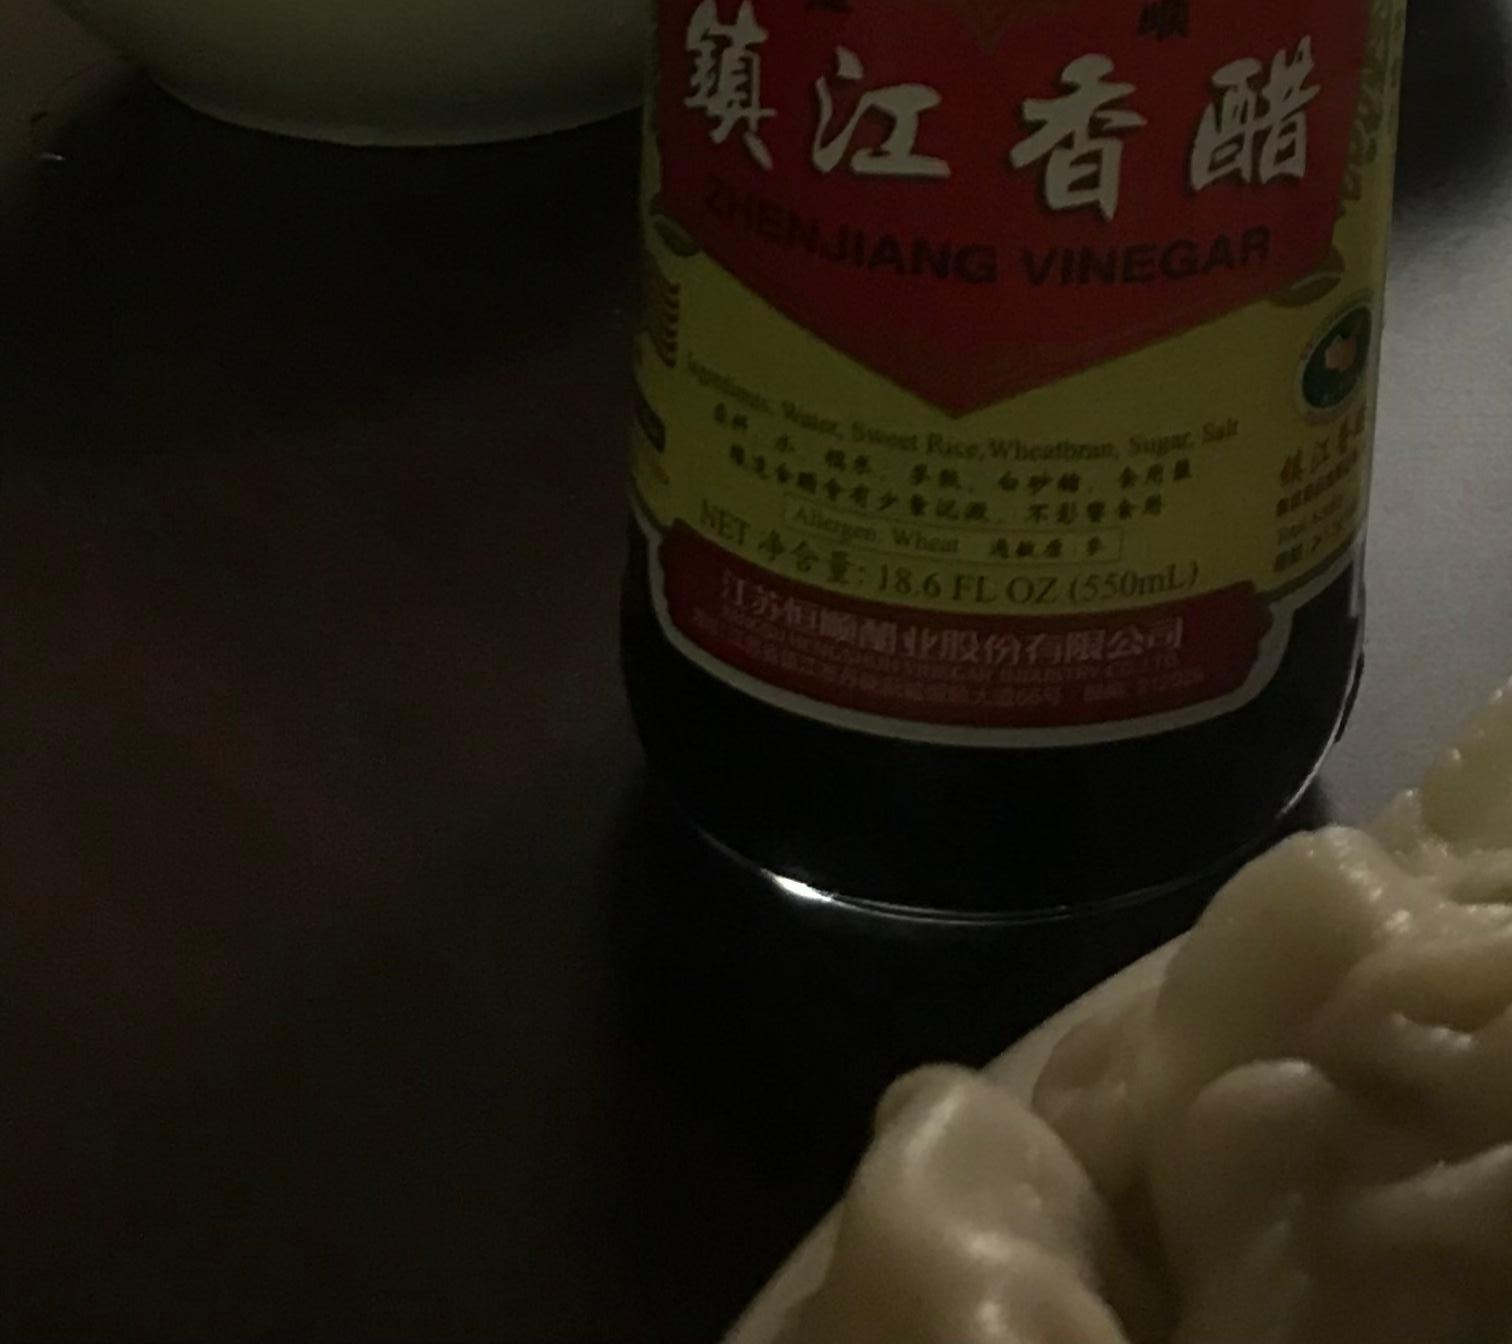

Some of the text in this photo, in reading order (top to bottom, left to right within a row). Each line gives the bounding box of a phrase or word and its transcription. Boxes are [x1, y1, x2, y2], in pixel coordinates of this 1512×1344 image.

[702, 178, 1272, 287] ZHENJIANG VINEGAR
[878, 563, 942, 599] 18.6
[952, 573, 998, 604] FL
[1005, 575, 1061, 605] OZ
[1068, 561, 1199, 606] (550mL)
